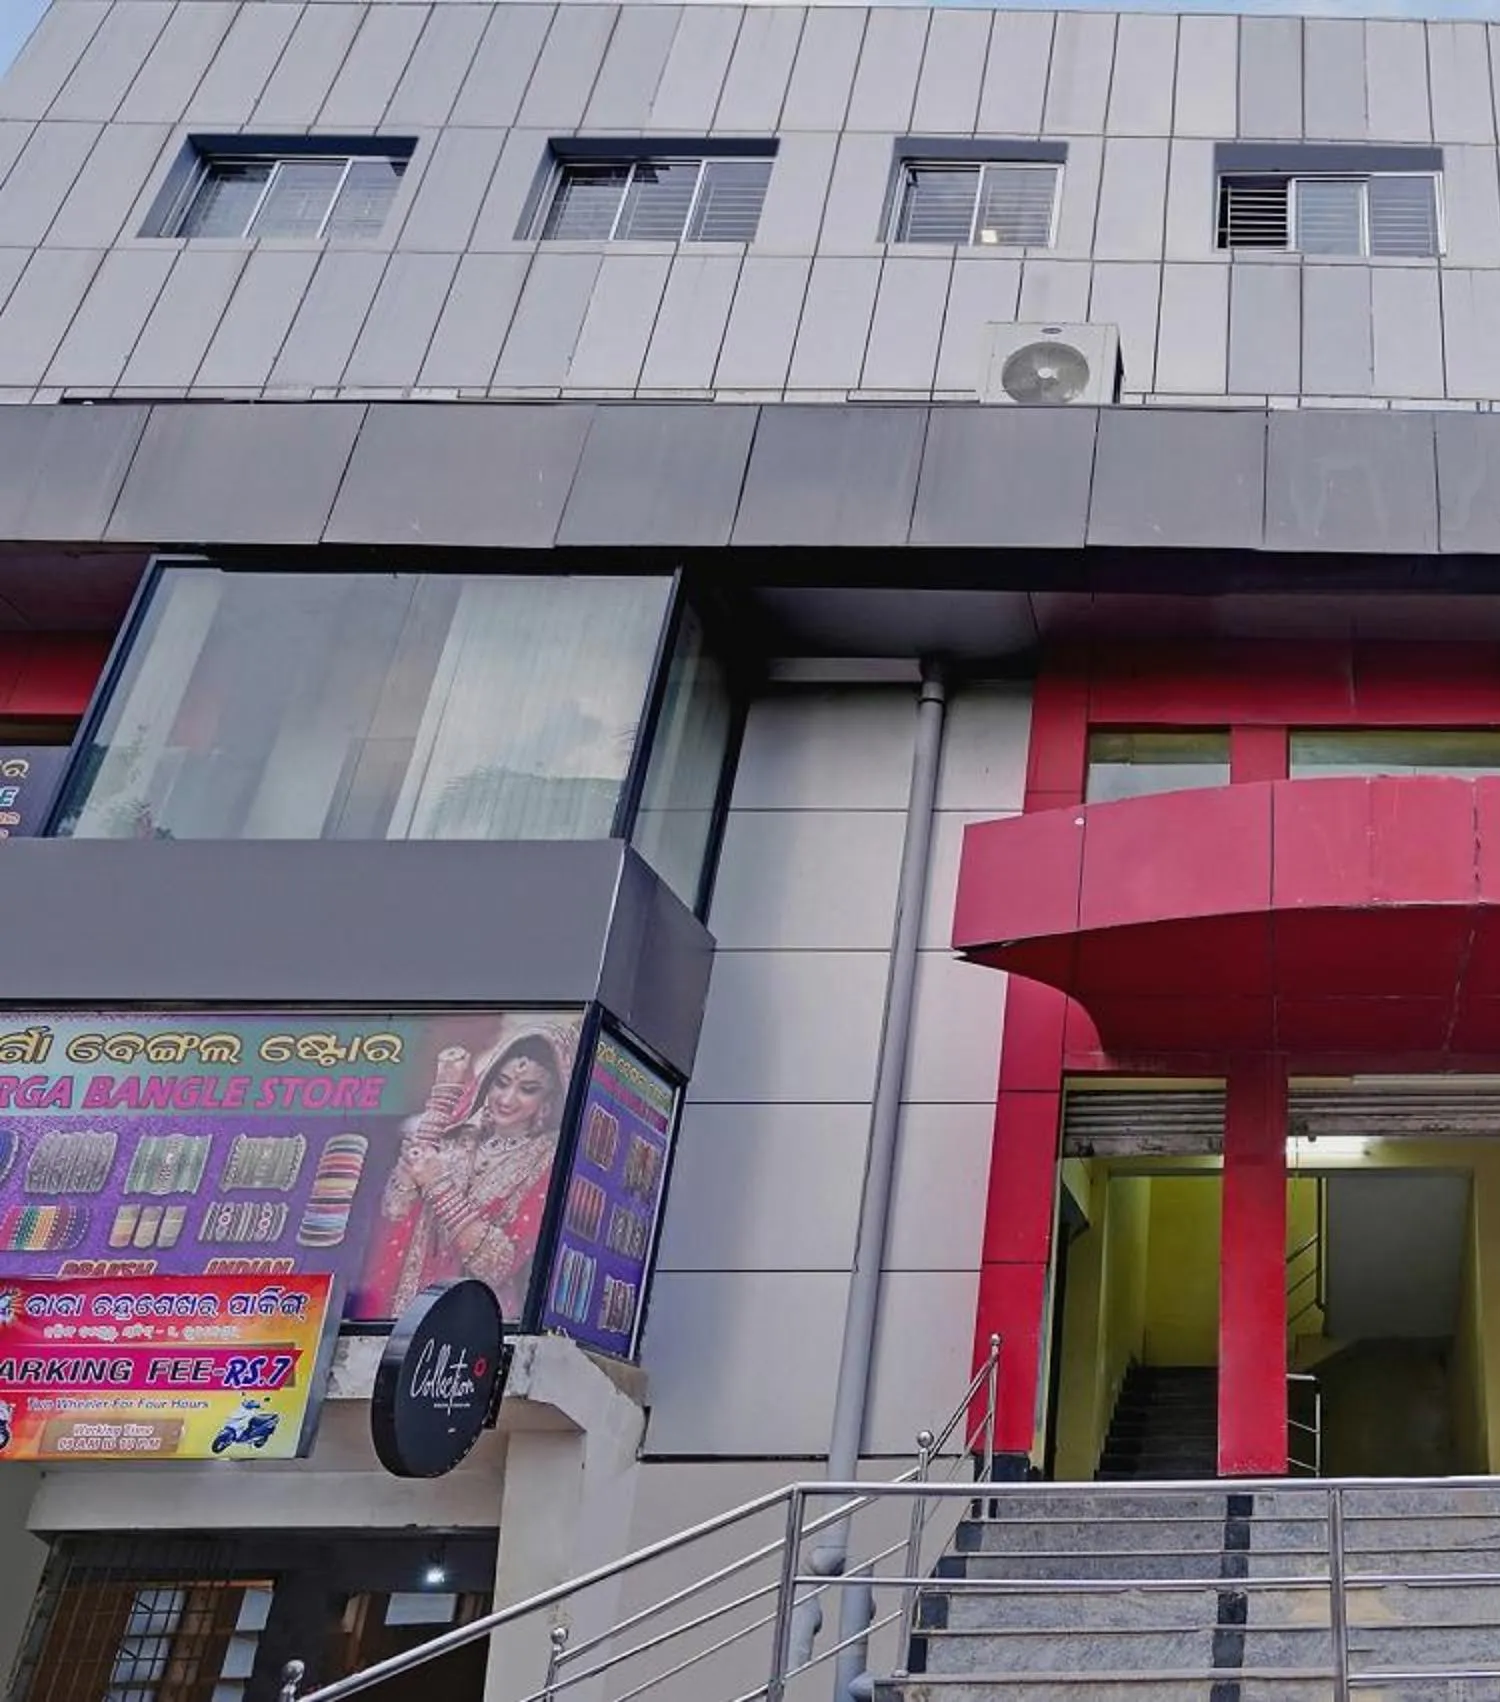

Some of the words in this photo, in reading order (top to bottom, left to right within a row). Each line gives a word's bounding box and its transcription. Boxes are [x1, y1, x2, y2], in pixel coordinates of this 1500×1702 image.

[81, 1075, 249, 1110] BANGLE
[254, 1075, 386, 1110] STORE
[25, 1293, 86, 1317] ବାବା
[0, 1357, 134, 1384] ARKING
[170, 1397, 209, 1409] Hours
